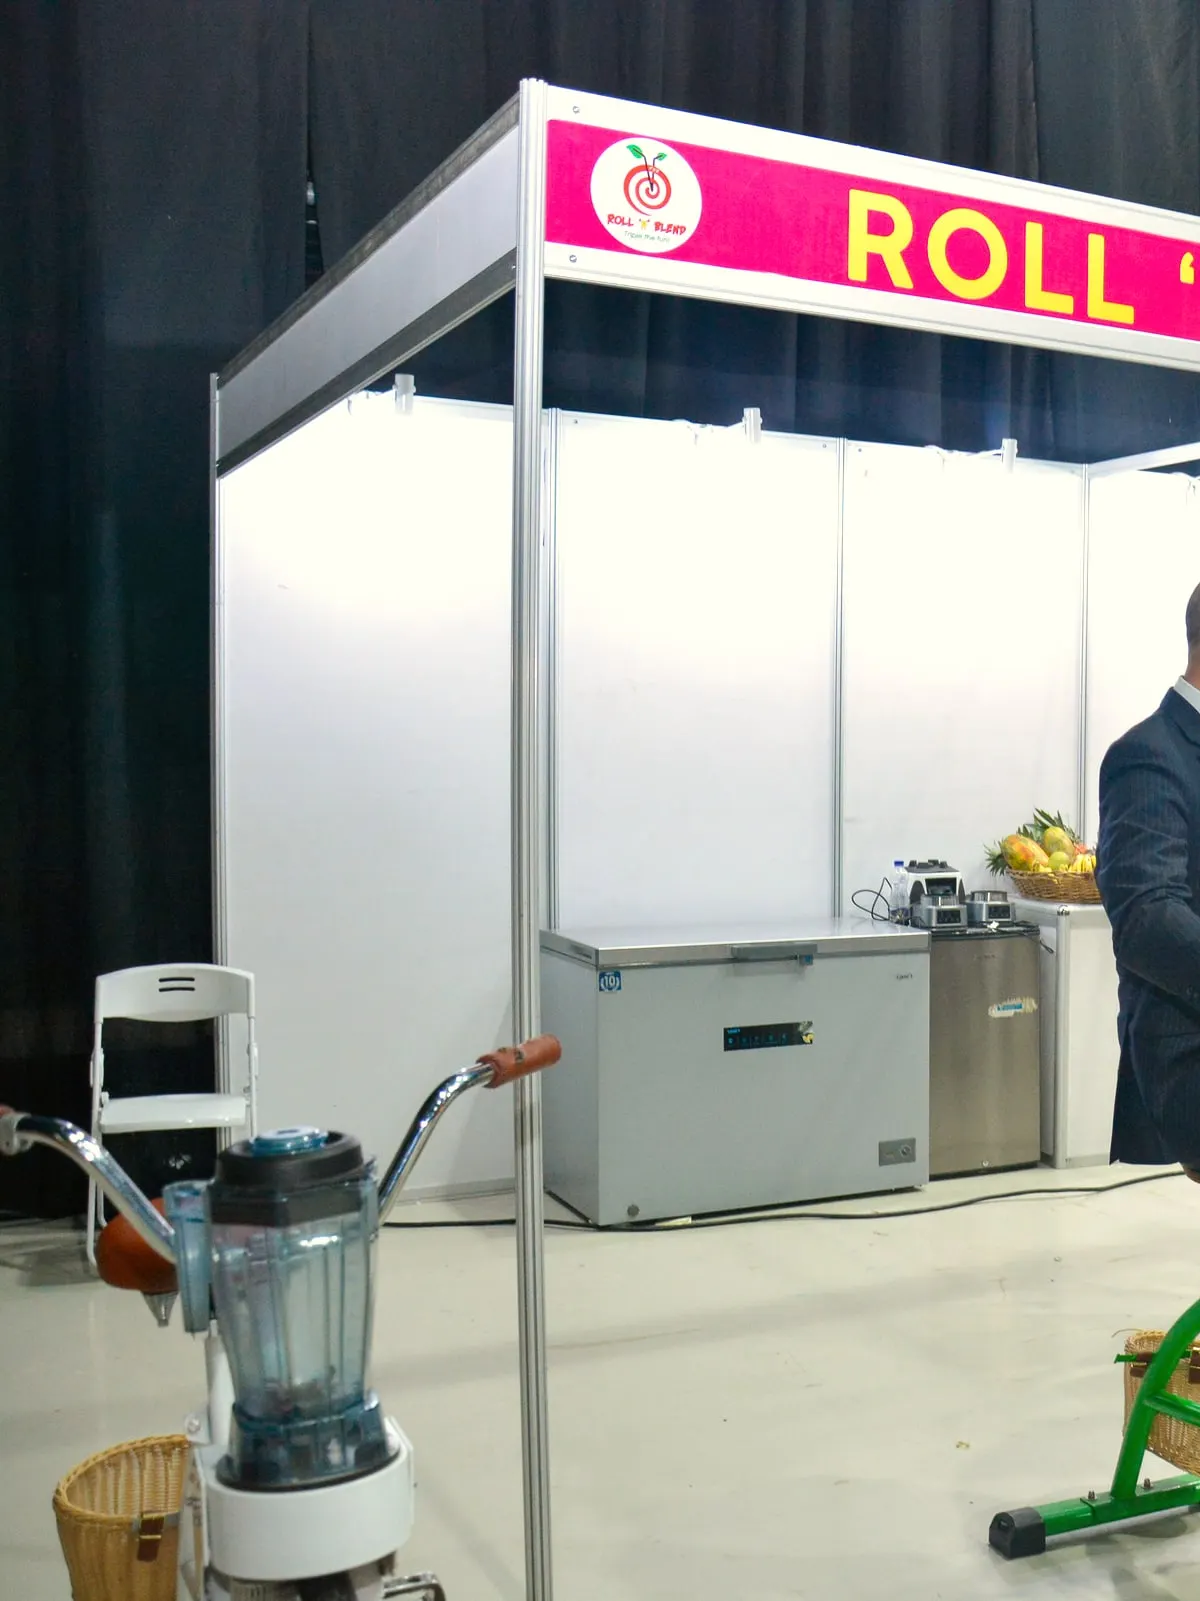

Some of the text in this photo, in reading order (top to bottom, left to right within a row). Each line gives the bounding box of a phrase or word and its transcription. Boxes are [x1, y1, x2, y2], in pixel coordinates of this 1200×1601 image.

[607, 213, 634, 227] ROLL
[654, 221, 687, 236] BLEND
[848, 188, 1135, 325] ROLL
